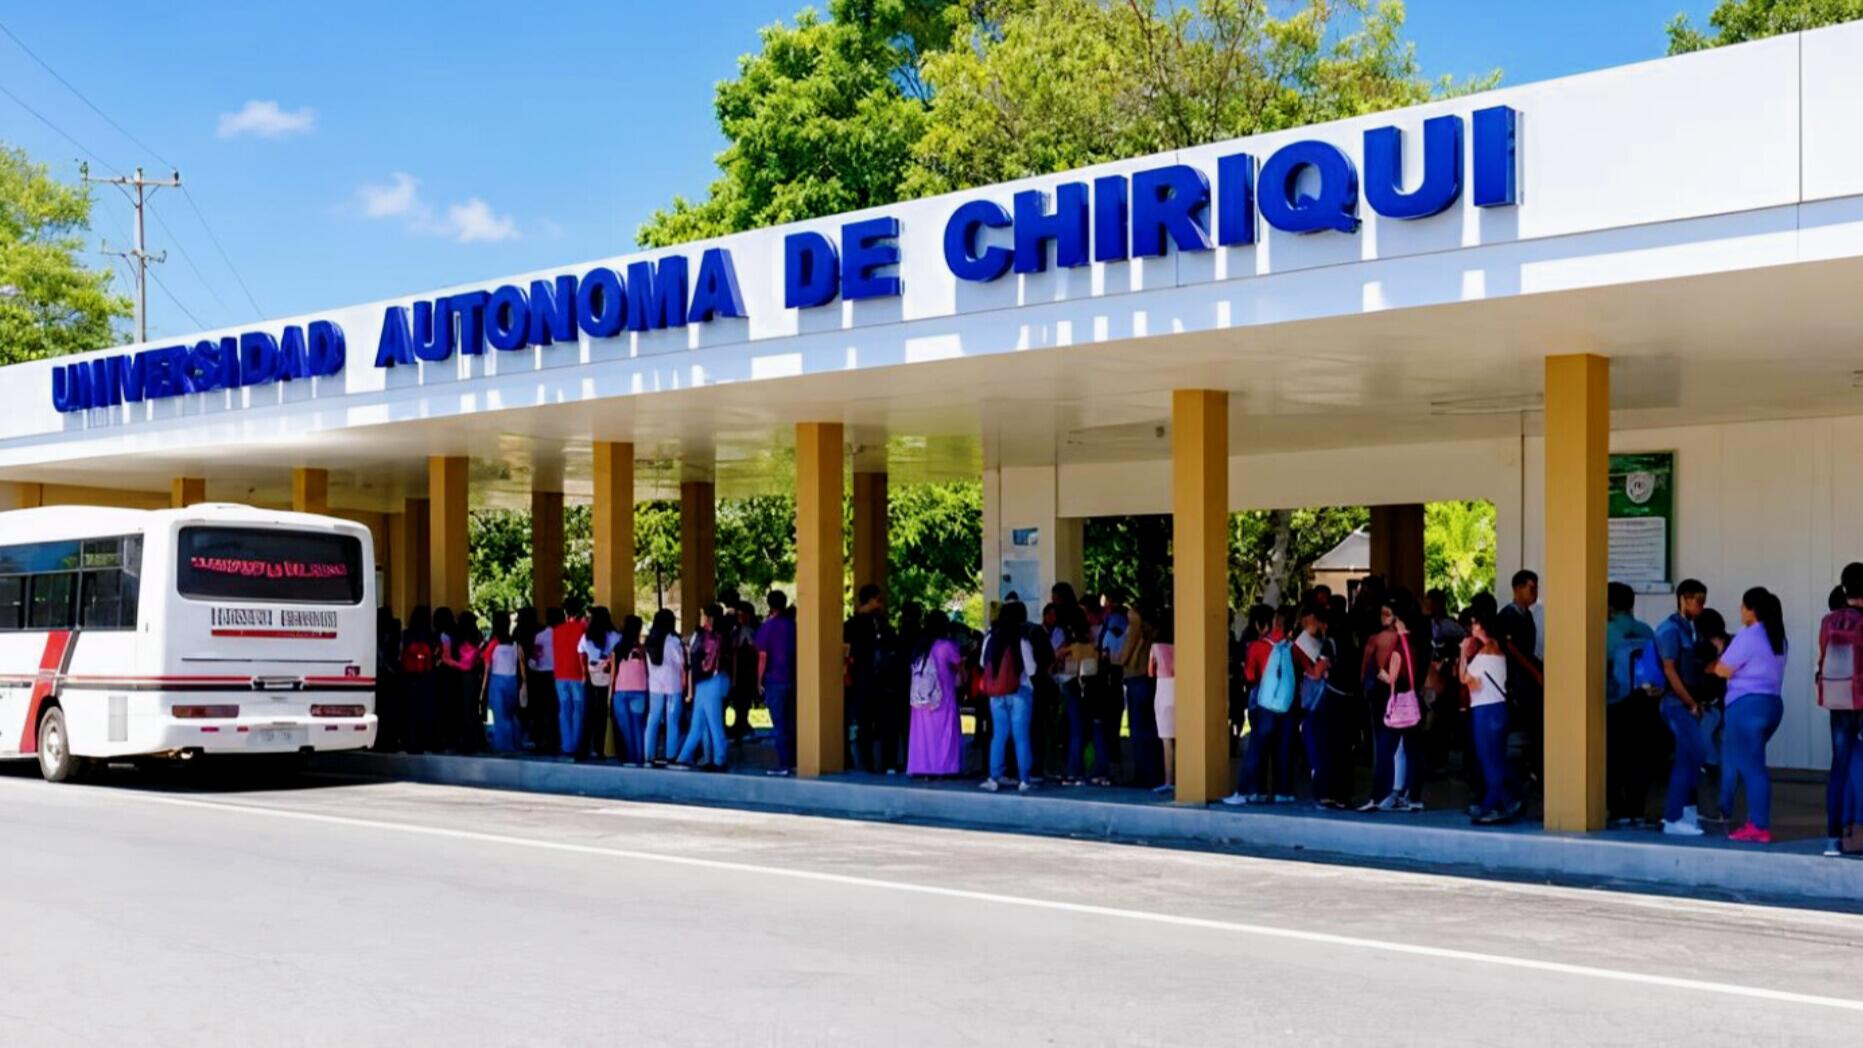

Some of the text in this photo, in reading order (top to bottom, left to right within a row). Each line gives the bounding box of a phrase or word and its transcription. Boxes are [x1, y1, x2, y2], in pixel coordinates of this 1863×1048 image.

[52, 105, 1521, 413] UNIVERSIDAD AUTONOMA DE CHIRIQUI
